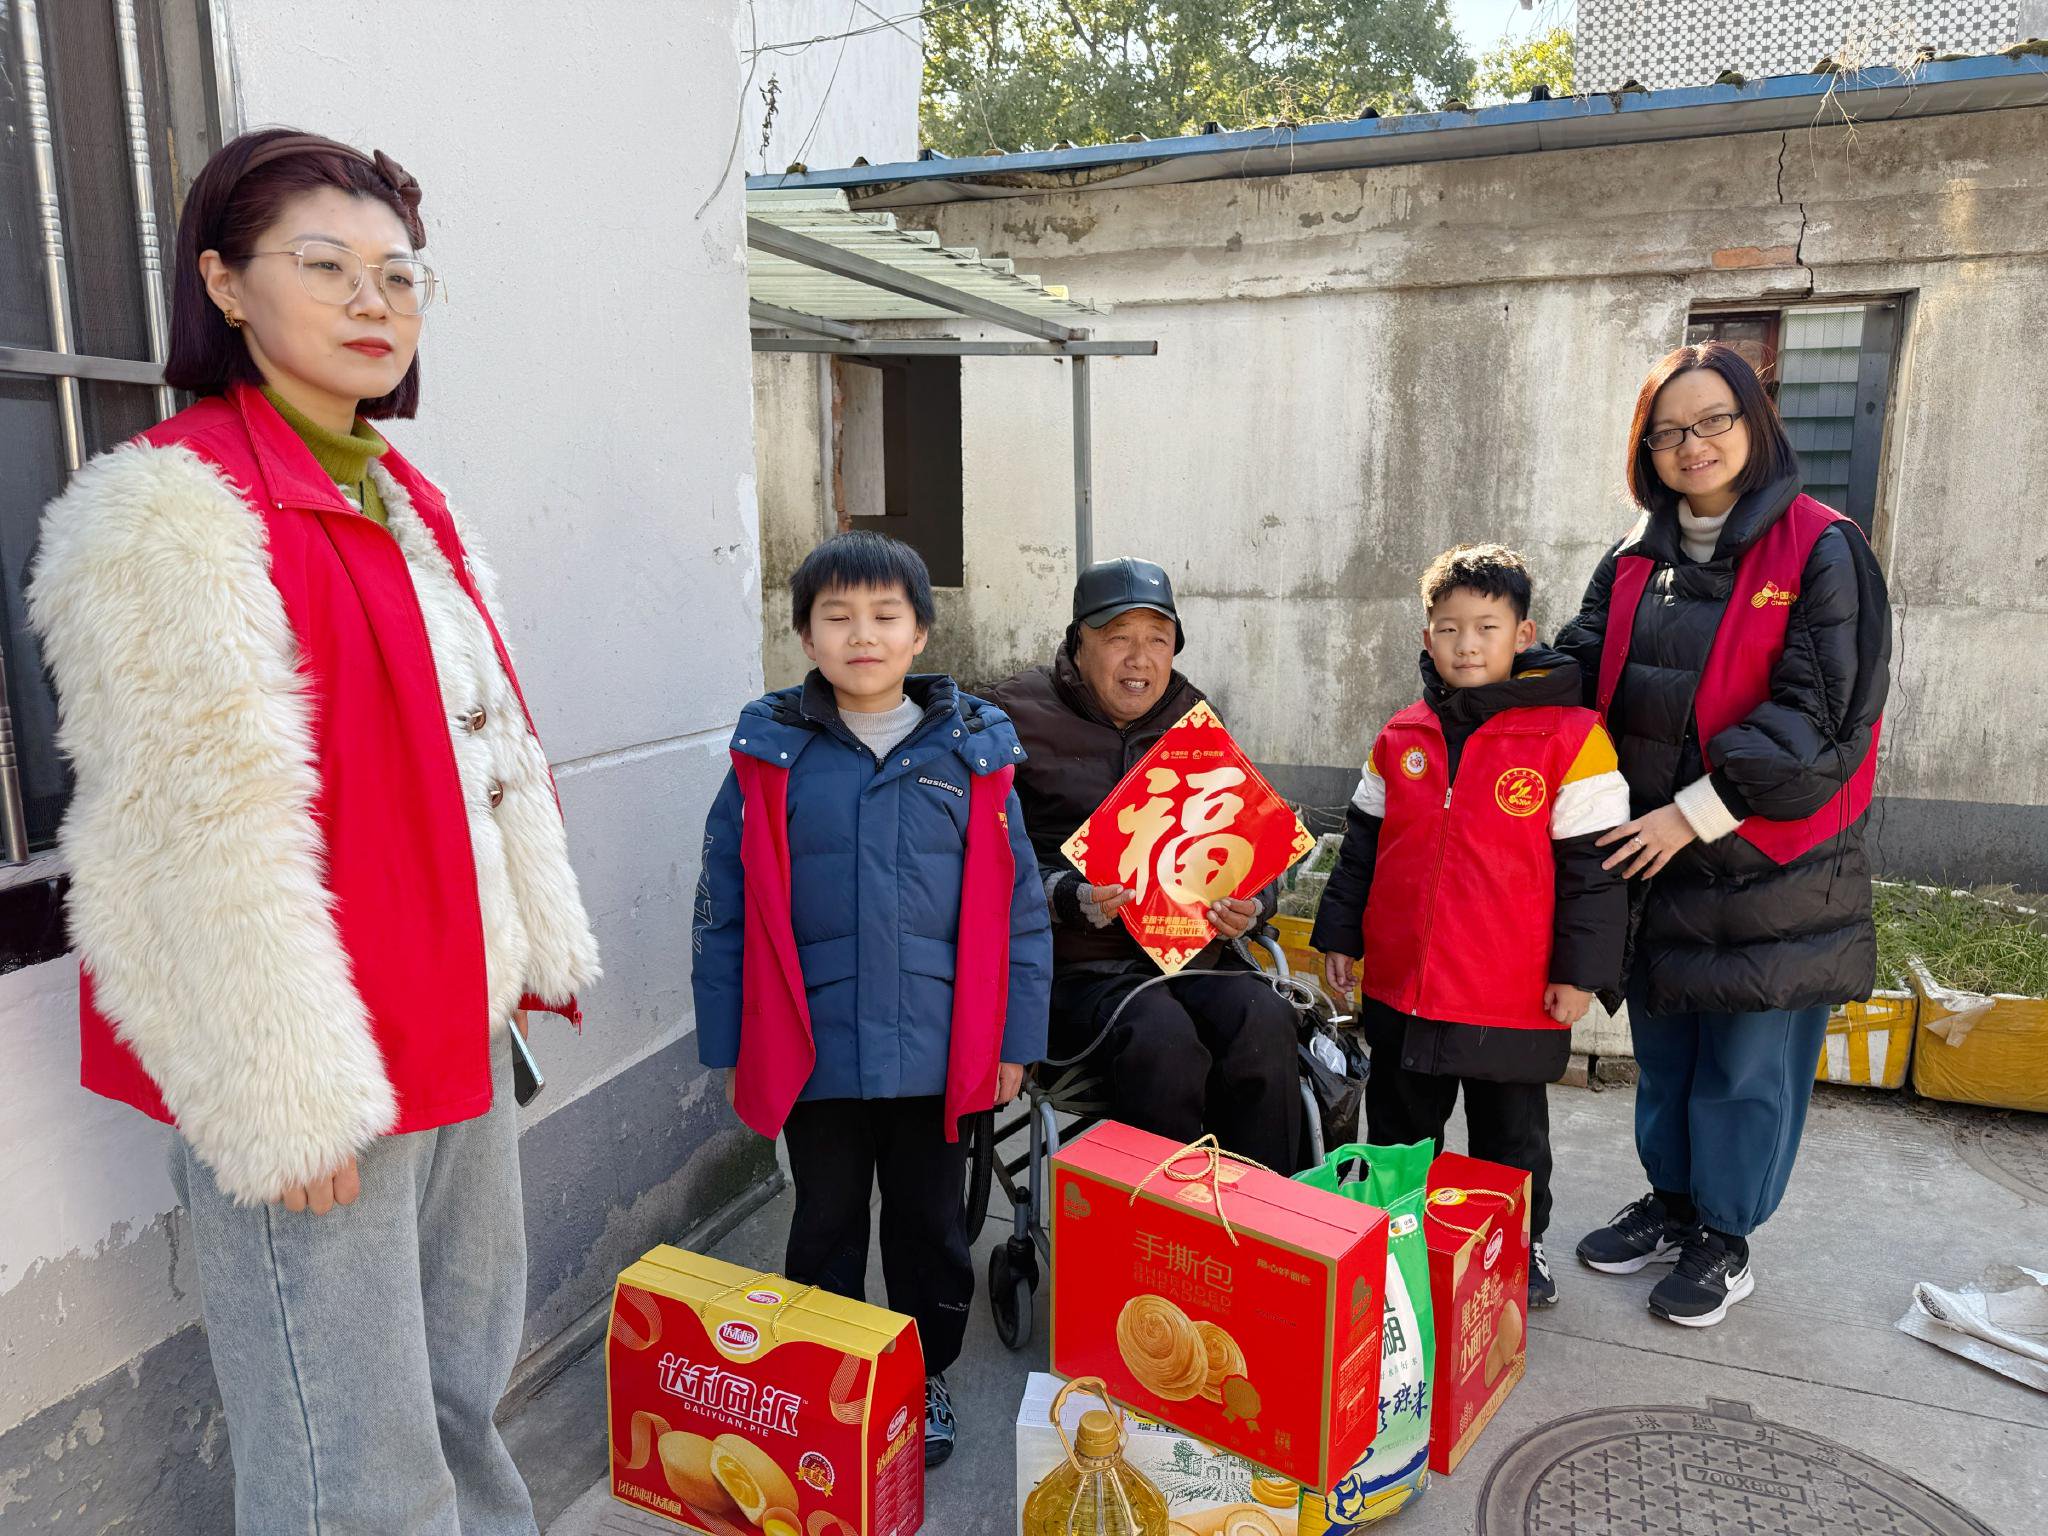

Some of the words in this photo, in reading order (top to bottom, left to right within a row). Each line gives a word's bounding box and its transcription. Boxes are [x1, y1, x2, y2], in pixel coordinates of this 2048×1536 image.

[918, 776, 964, 797] Bosideng
[1117, 767, 1254, 905] 福
[1132, 1229, 1234, 1293] 手撕包
[1460, 1275, 1491, 1342] 黑全麦
[1459, 1311, 1492, 1374] 小面包
